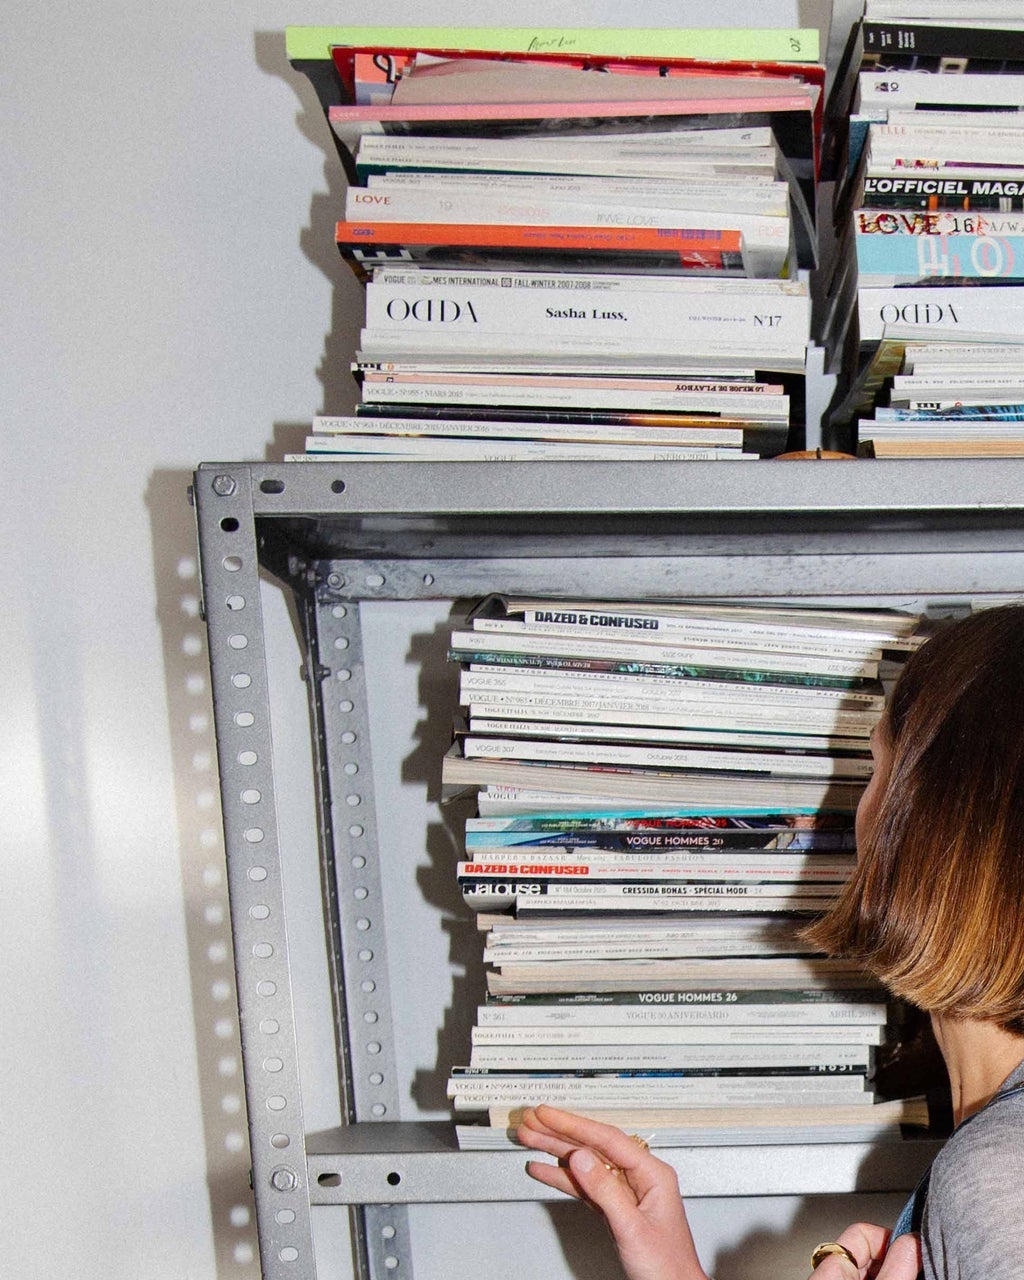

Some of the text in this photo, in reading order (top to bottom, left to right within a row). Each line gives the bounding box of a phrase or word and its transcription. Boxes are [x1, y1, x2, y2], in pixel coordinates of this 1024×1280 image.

[864, 178, 969, 195] L'OFFICIEL
[355, 194, 391, 206] LOVE
[858, 213, 942, 235] LOVE
[952, 216, 974, 233] 16
[384, 275, 406, 284] VOGUE
[449, 276, 499, 287] INTERNATIONAL
[546, 307, 586, 319] Sasha
[592, 309, 628, 321] Luss.
[675, 384, 715, 393] PLAYBOY
[535, 610, 659, 631] DAZED & CONFUSED
[466, 676, 492, 686] VOGUE
[469, 694, 498, 703] VOGUE
[534, 695, 579, 707] DÉCEMBRE
[475, 744, 501, 753] VOGUE
[487, 792, 518, 800] VOGUE
[626, 836, 662, 846] VOGUE
[664, 836, 710, 846] HOMMES
[464, 864, 590, 876] DAZED & CONFUSED
[466, 882, 542, 896] Jalouse
[622, 886, 659, 895] CRESSIDA
[694, 886, 726, 895] SPÉCIAL
[726, 887, 749, 895] MODE
[638, 992, 738, 1003] VOGUE HOMMES 26
[626, 1012, 657, 1020] VOGUE
[455, 1083, 484, 1092] VOGUE
